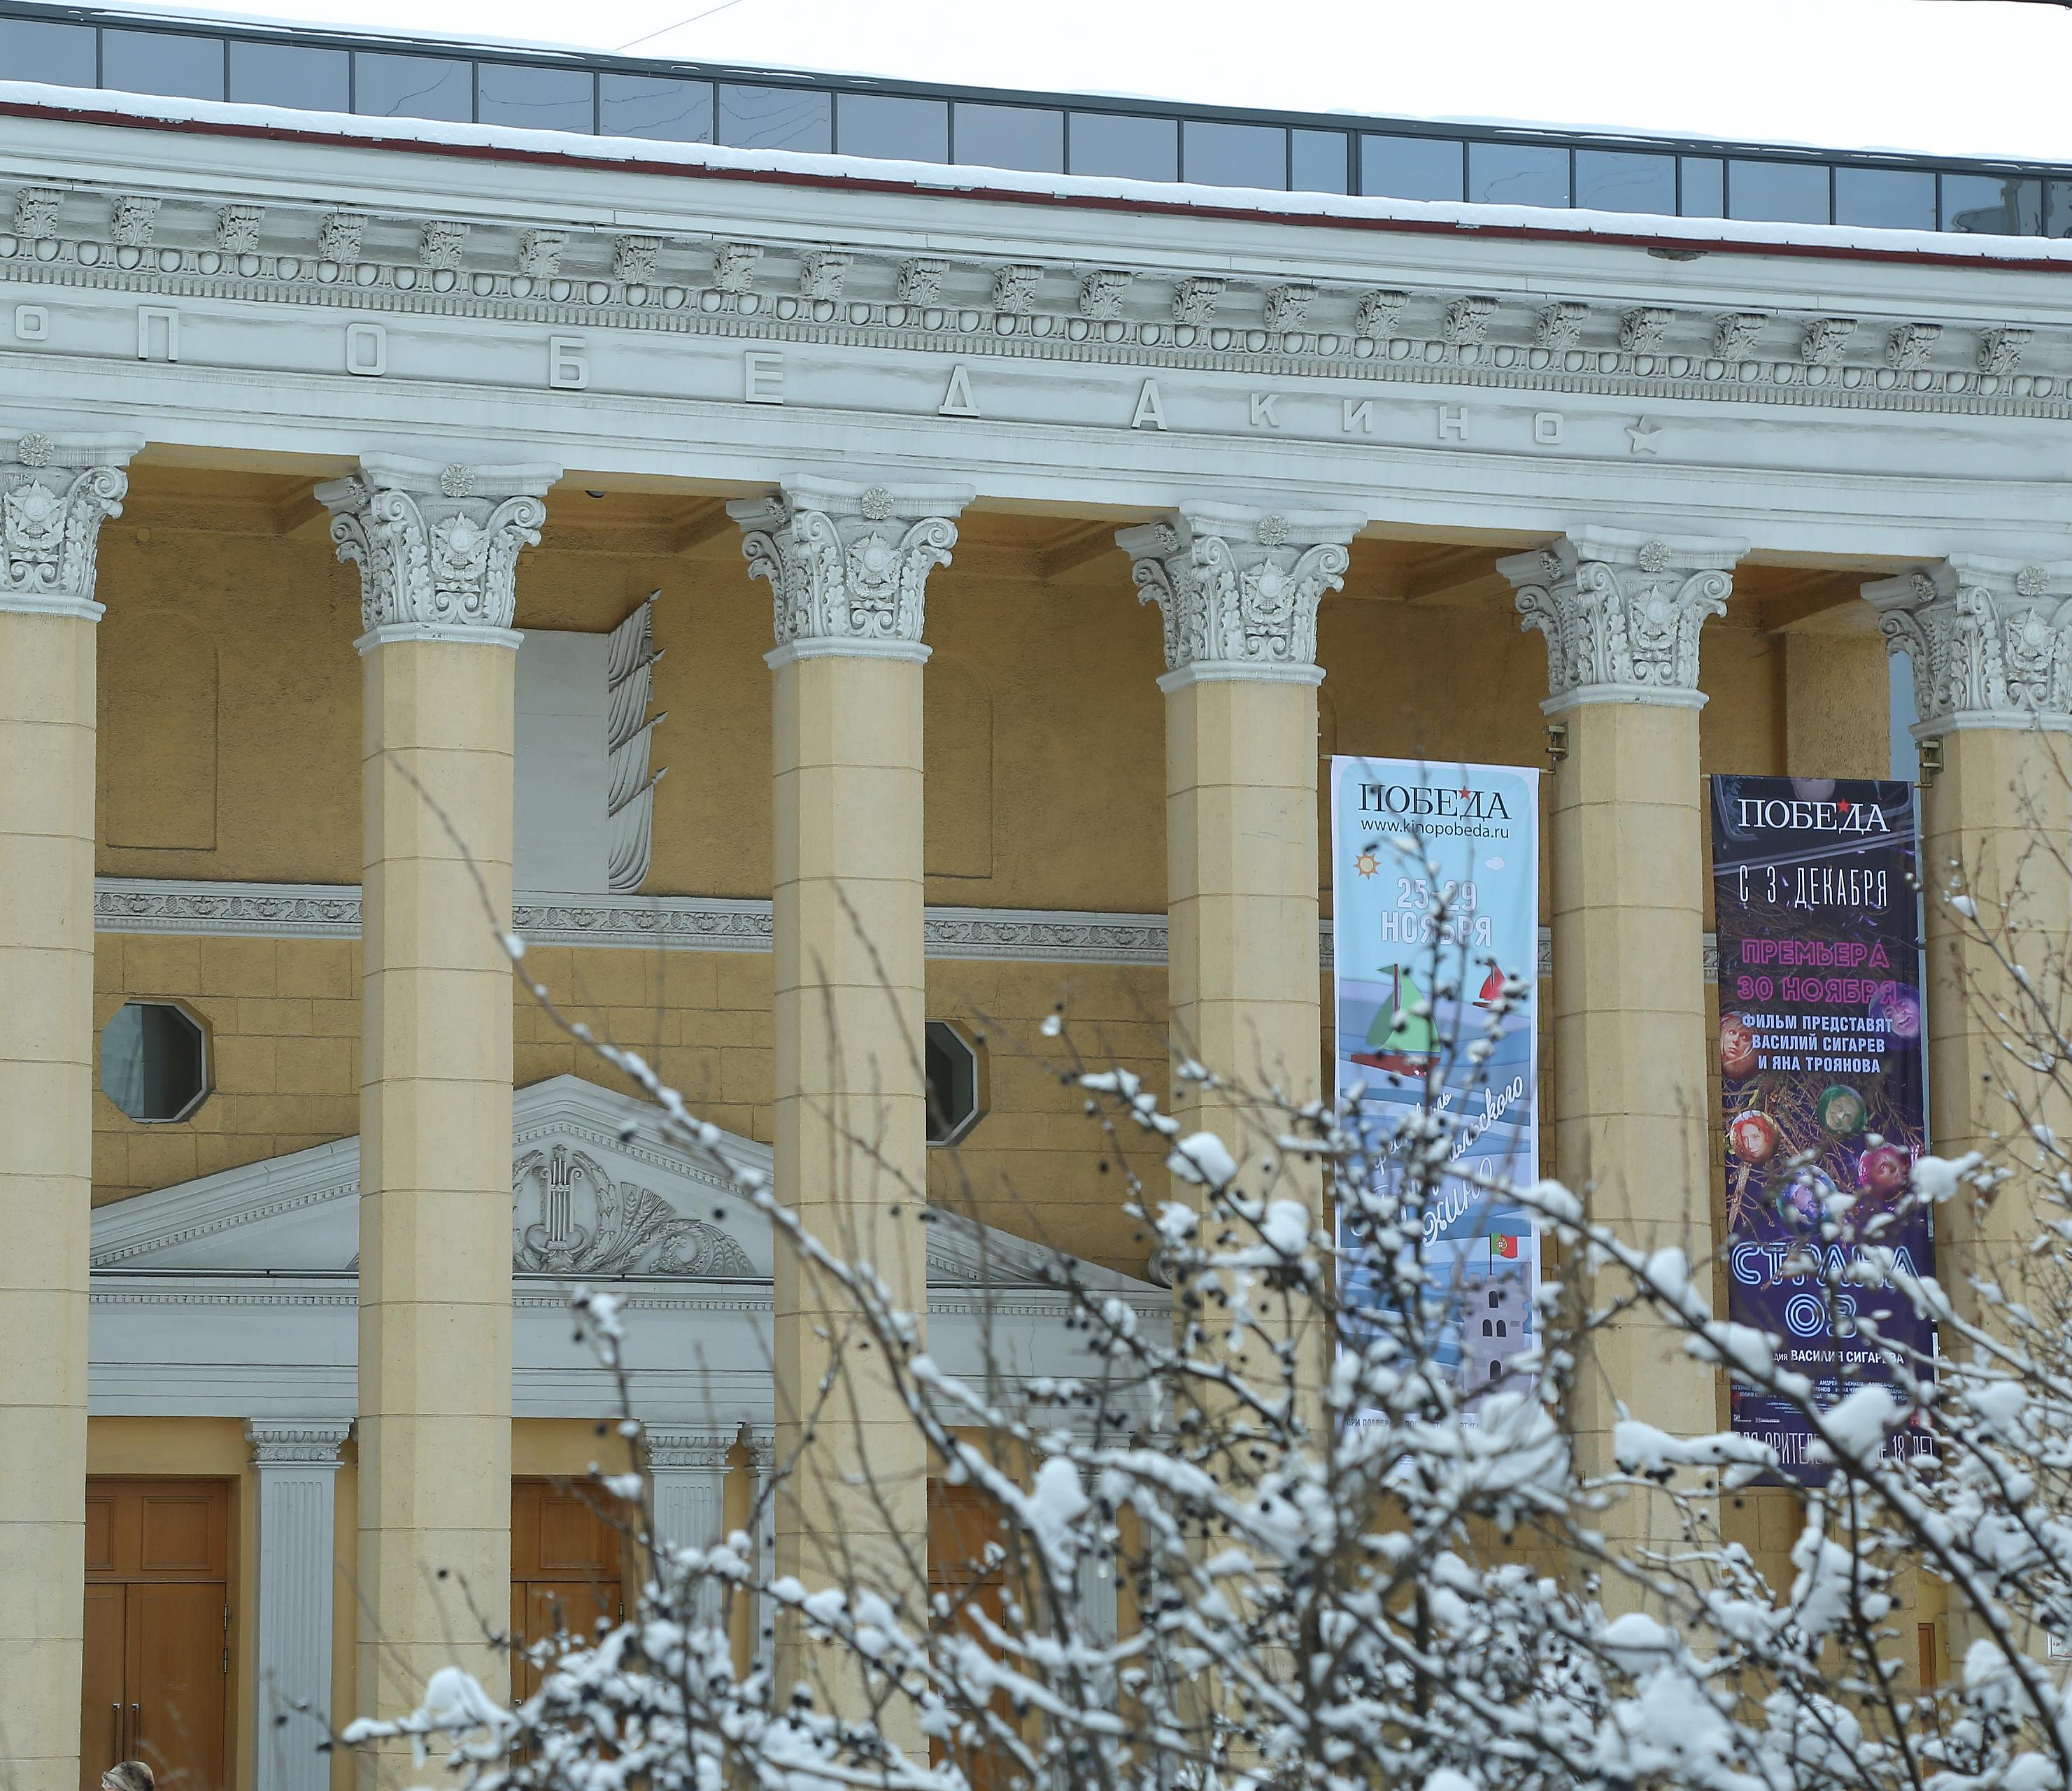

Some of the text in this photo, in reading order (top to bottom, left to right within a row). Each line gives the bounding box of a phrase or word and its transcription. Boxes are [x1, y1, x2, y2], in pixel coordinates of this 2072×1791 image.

[138, 305, 1168, 432] ПОБЕДА
[1249, 392, 1565, 446] КИНО
[1357, 783, 1512, 822] ПОБЕДА
[1738, 798, 1891, 835] ПОБЕДА
[1361, 819, 1510, 839] www.kinopobeda.ru
[1396, 877, 1477, 912] 25-29
[1739, 865, 1887, 909] С 3 ДЕКАБРЯ
[1741, 939, 1890, 968] ПРЕМЬЕРА
[1737, 975, 1897, 1005] 30 НОЯБРЯ
[1742, 1014, 1893, 1033] ФИЛЬМ ПРЕДСТАВЯТ
[1752, 1033, 1885, 1053] ВАСИЛИЙ СИГАРЕВ
[1758, 1055, 1881, 1073] И ЯНА ТРОЯНОВА
[1845, 1350, 1904, 1365] СИГАРВА
